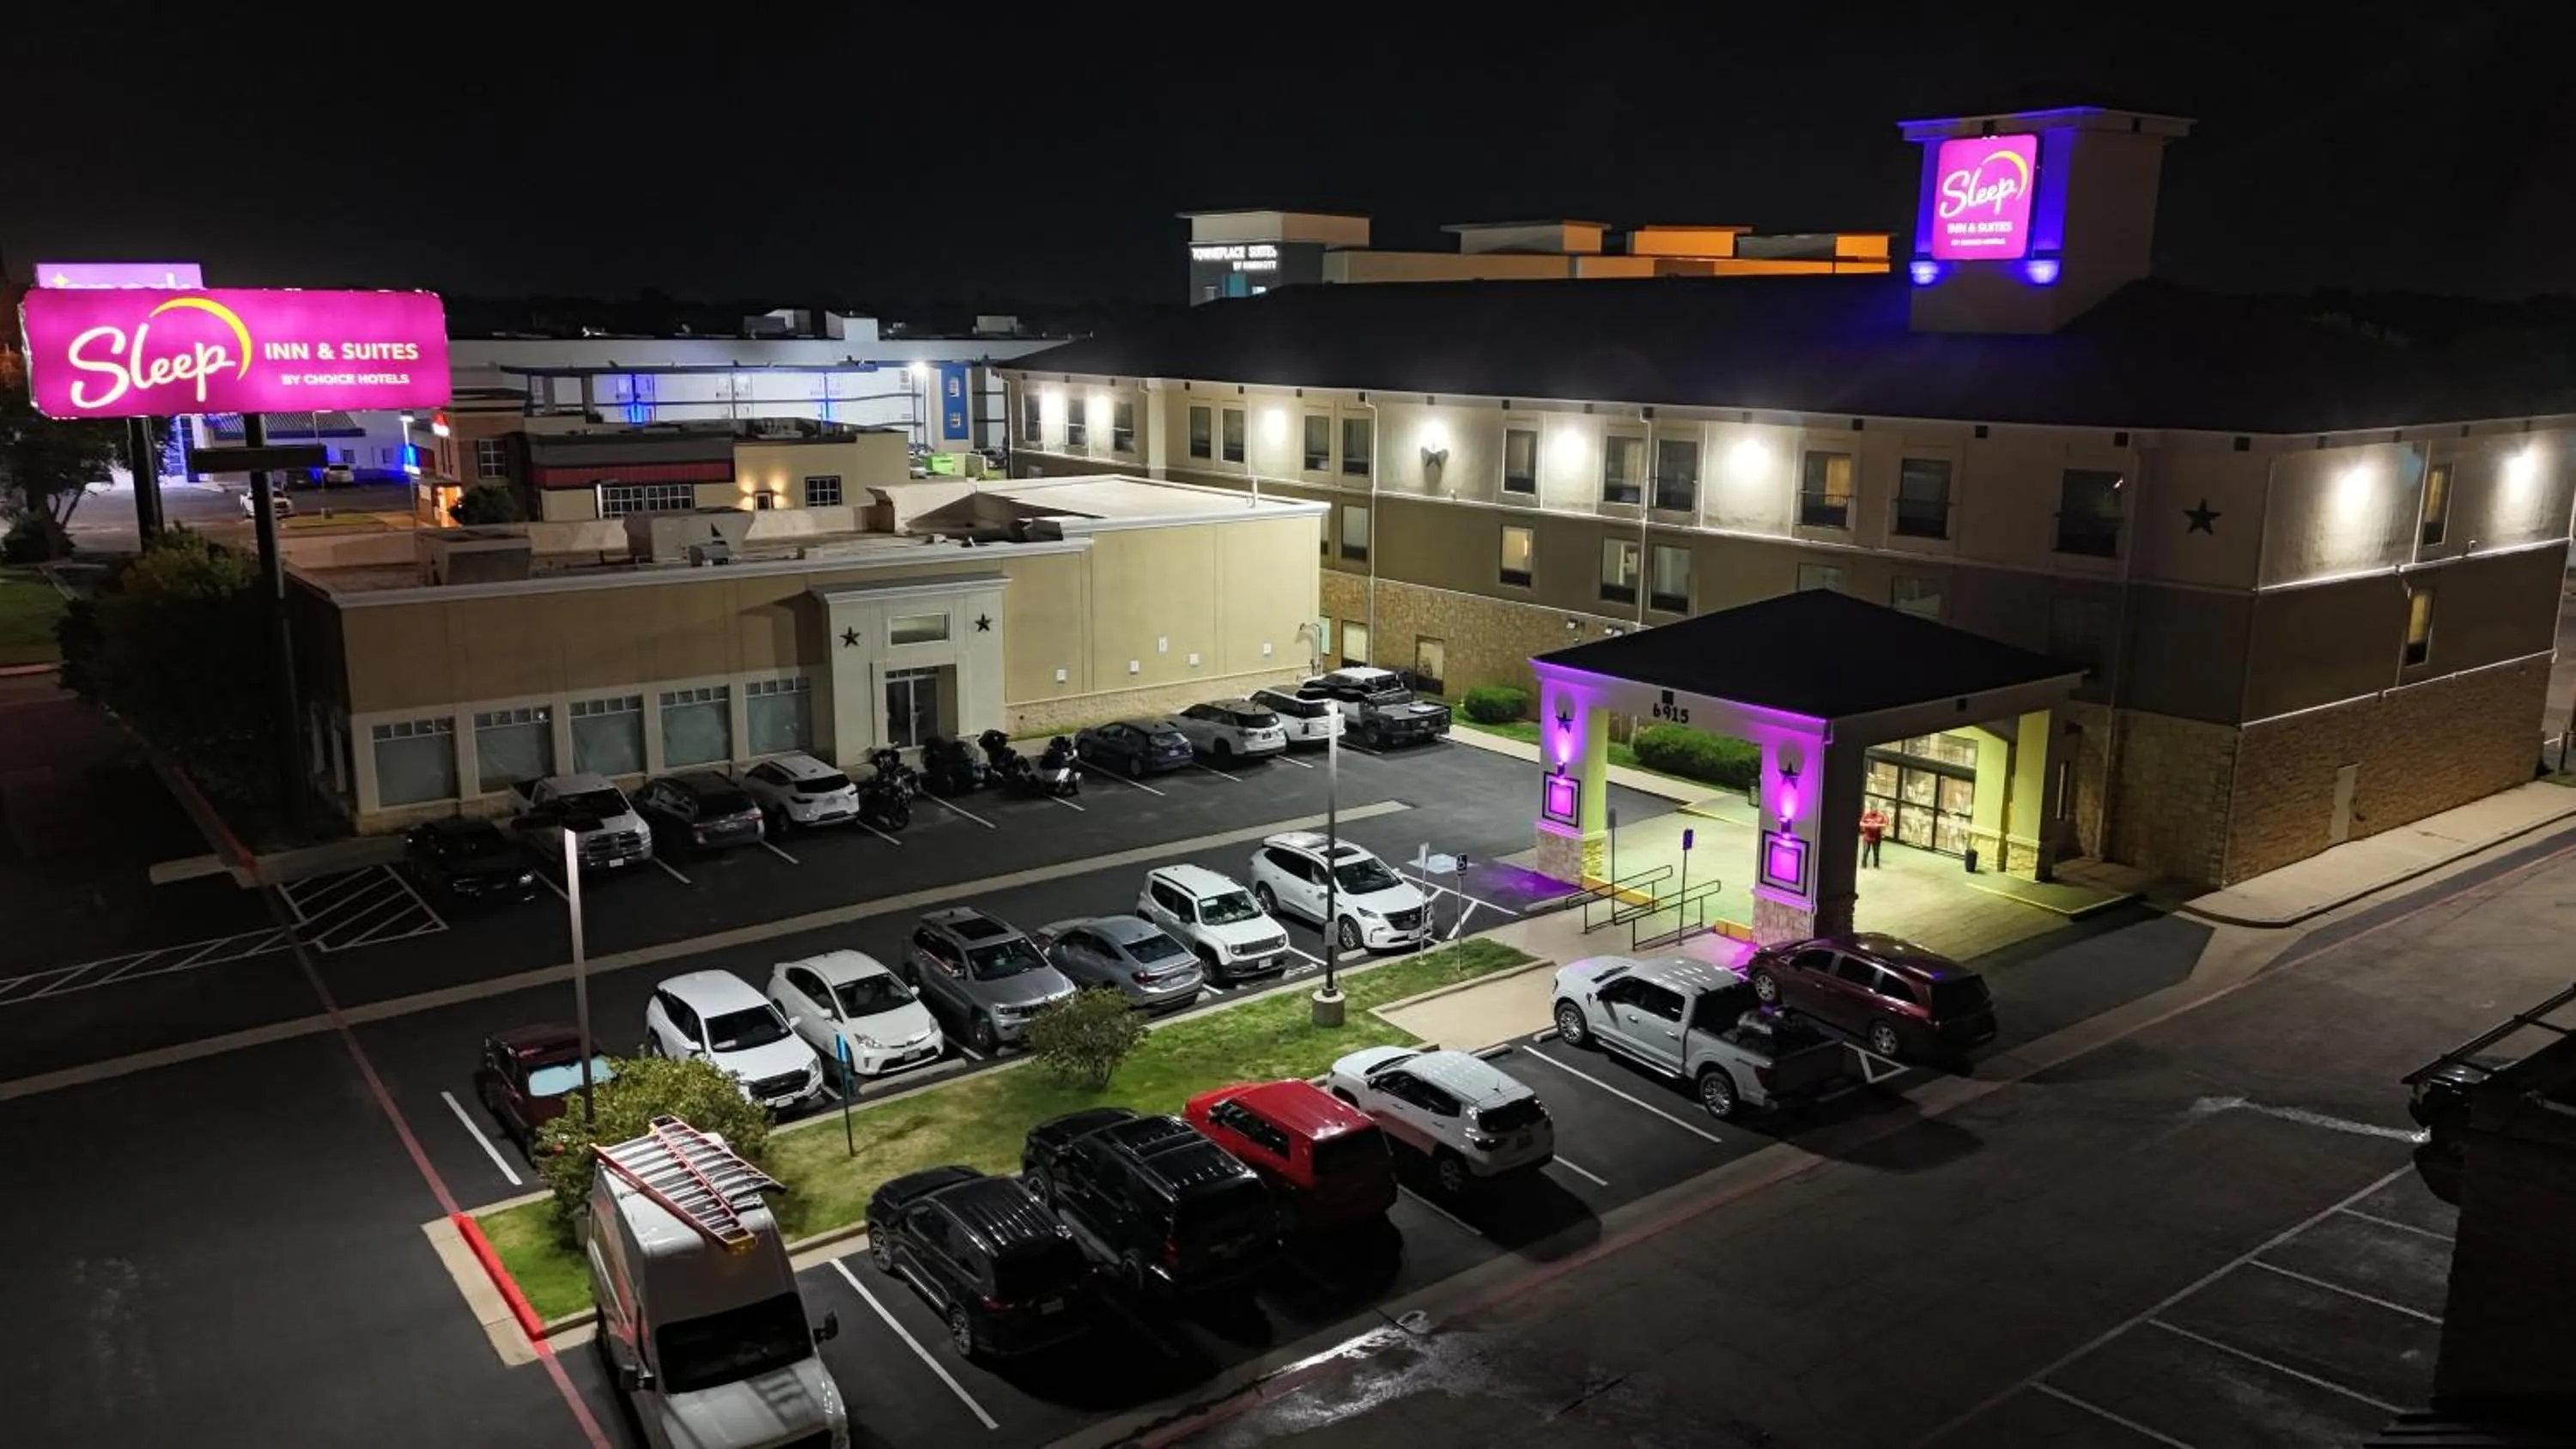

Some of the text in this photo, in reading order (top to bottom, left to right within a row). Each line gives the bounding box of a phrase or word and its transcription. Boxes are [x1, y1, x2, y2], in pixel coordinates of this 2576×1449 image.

[1939, 167, 2017, 218] Sleep
[264, 343, 419, 361] INN & SUITES
[69, 323, 236, 409] Sleep
[281, 373, 410, 385] BY CHOICE HOTELS
[1653, 702, 1690, 724] 6915
